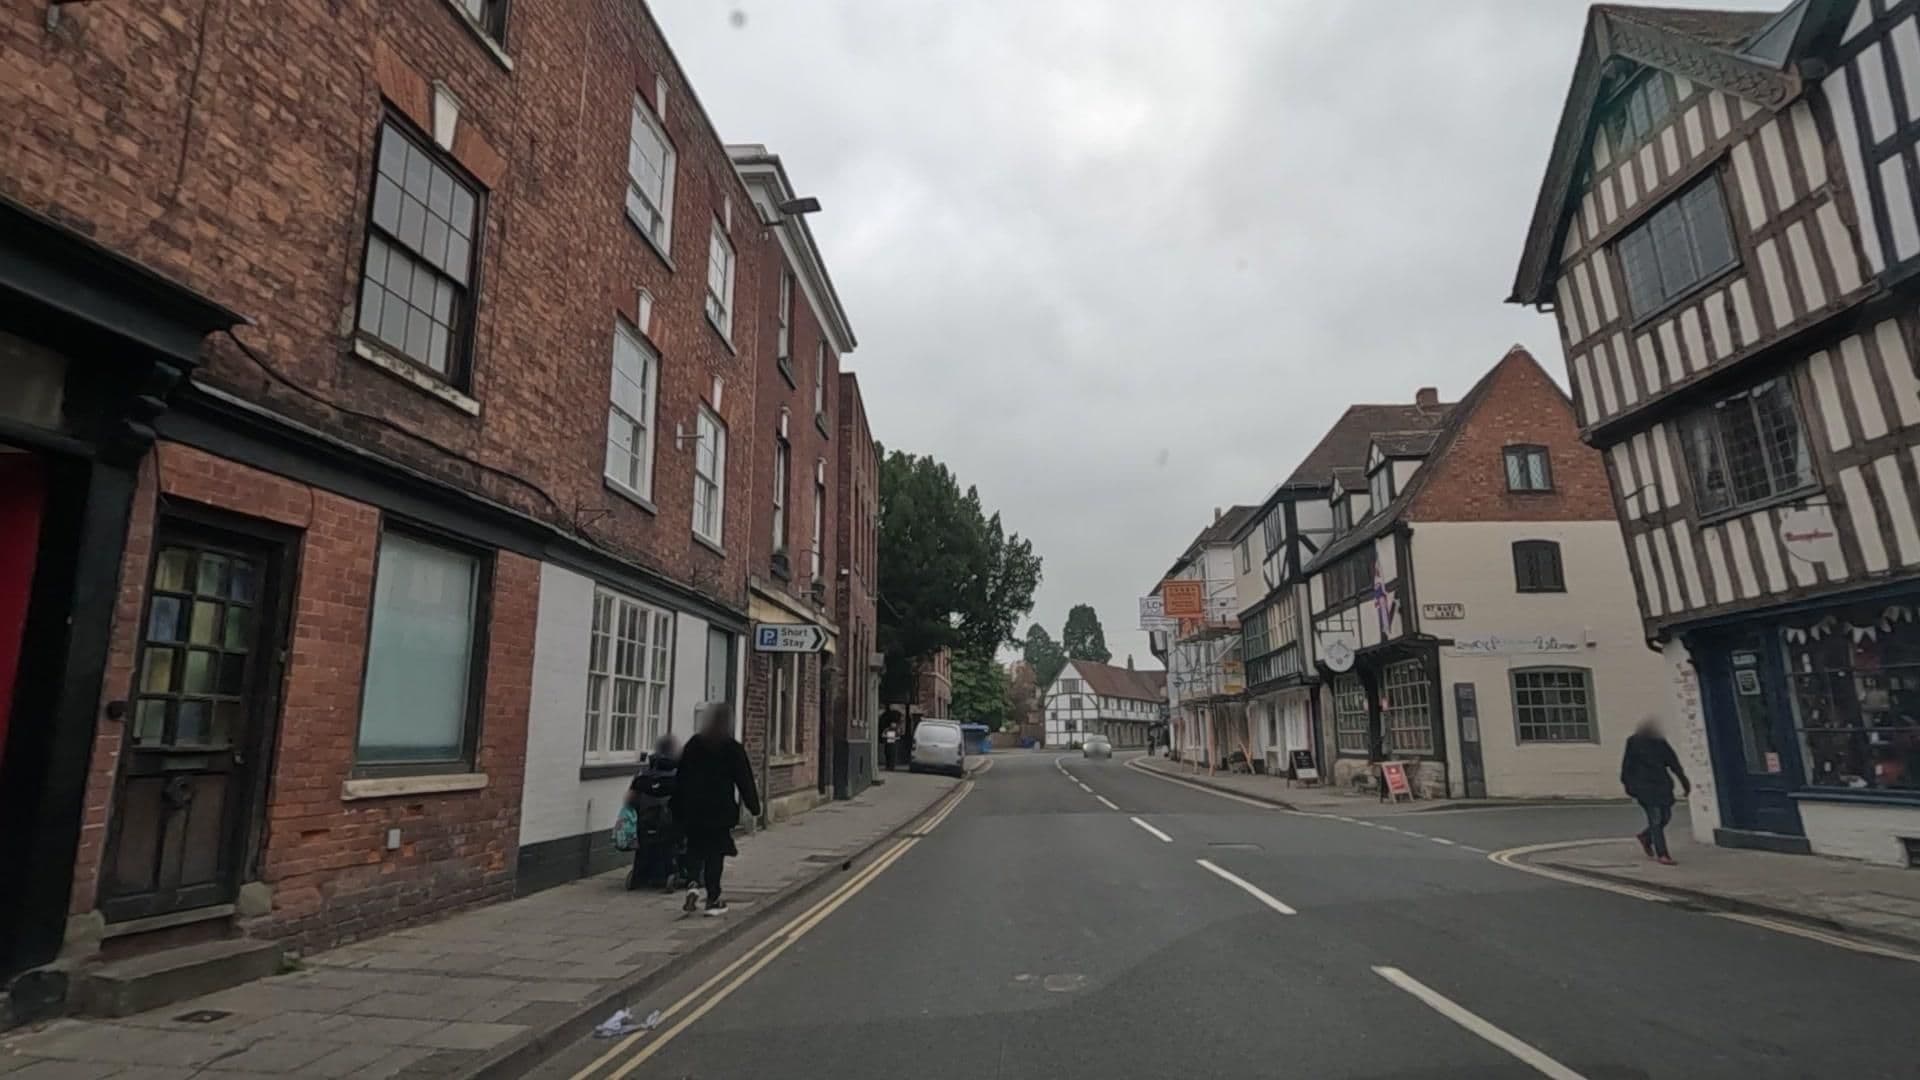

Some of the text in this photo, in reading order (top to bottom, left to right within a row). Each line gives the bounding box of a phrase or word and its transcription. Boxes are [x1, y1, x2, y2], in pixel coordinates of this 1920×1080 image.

[763, 627, 807, 644] P Short
[782, 638, 804, 648] Stay
